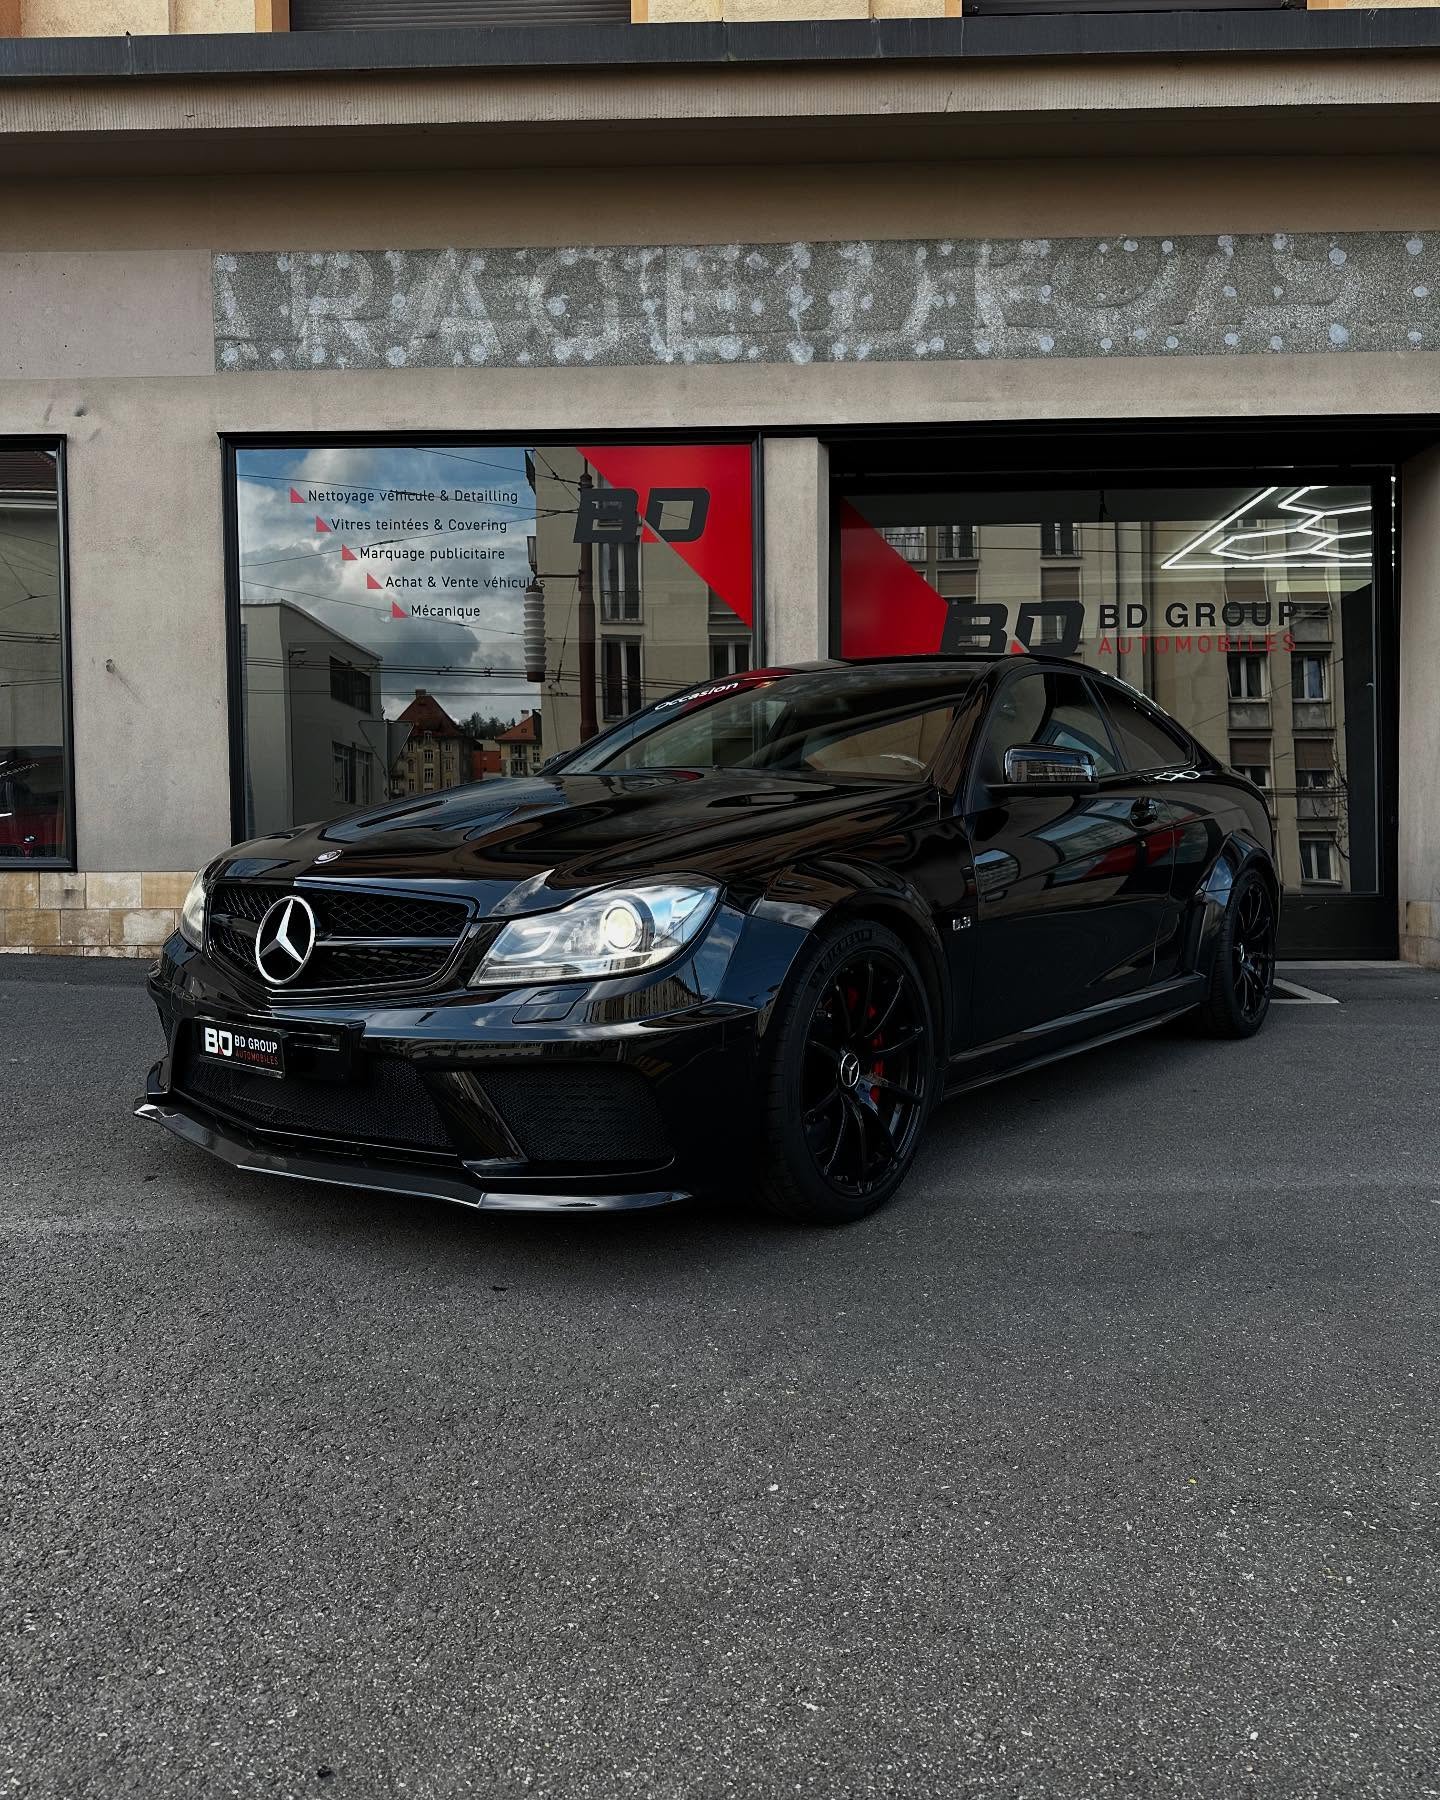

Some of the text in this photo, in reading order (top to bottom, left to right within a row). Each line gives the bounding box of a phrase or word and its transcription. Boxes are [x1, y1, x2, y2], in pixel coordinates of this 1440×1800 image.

[308, 488, 519, 505] Nettoyage véhicule & Detailling
[573, 487, 711, 543] BD
[331, 518, 507, 534] Vitres teintées & Covering
[360, 547, 505, 562] Marquage publicitaire
[385, 576, 422, 588] Achat
[427, 576, 437, 588] &
[441, 576, 479, 588] Vente
[411, 604, 481, 620] Mécanique
[1100, 601, 1299, 629] BD GROUP
[939, 602, 1085, 657] BD
[1099, 634, 1297, 655] AUTOMOBILES
[205, 1027, 232, 1056] BD
[235, 1035, 277, 1053] BD GROUP
[236, 1051, 278, 1065] AUTOMOBILES
